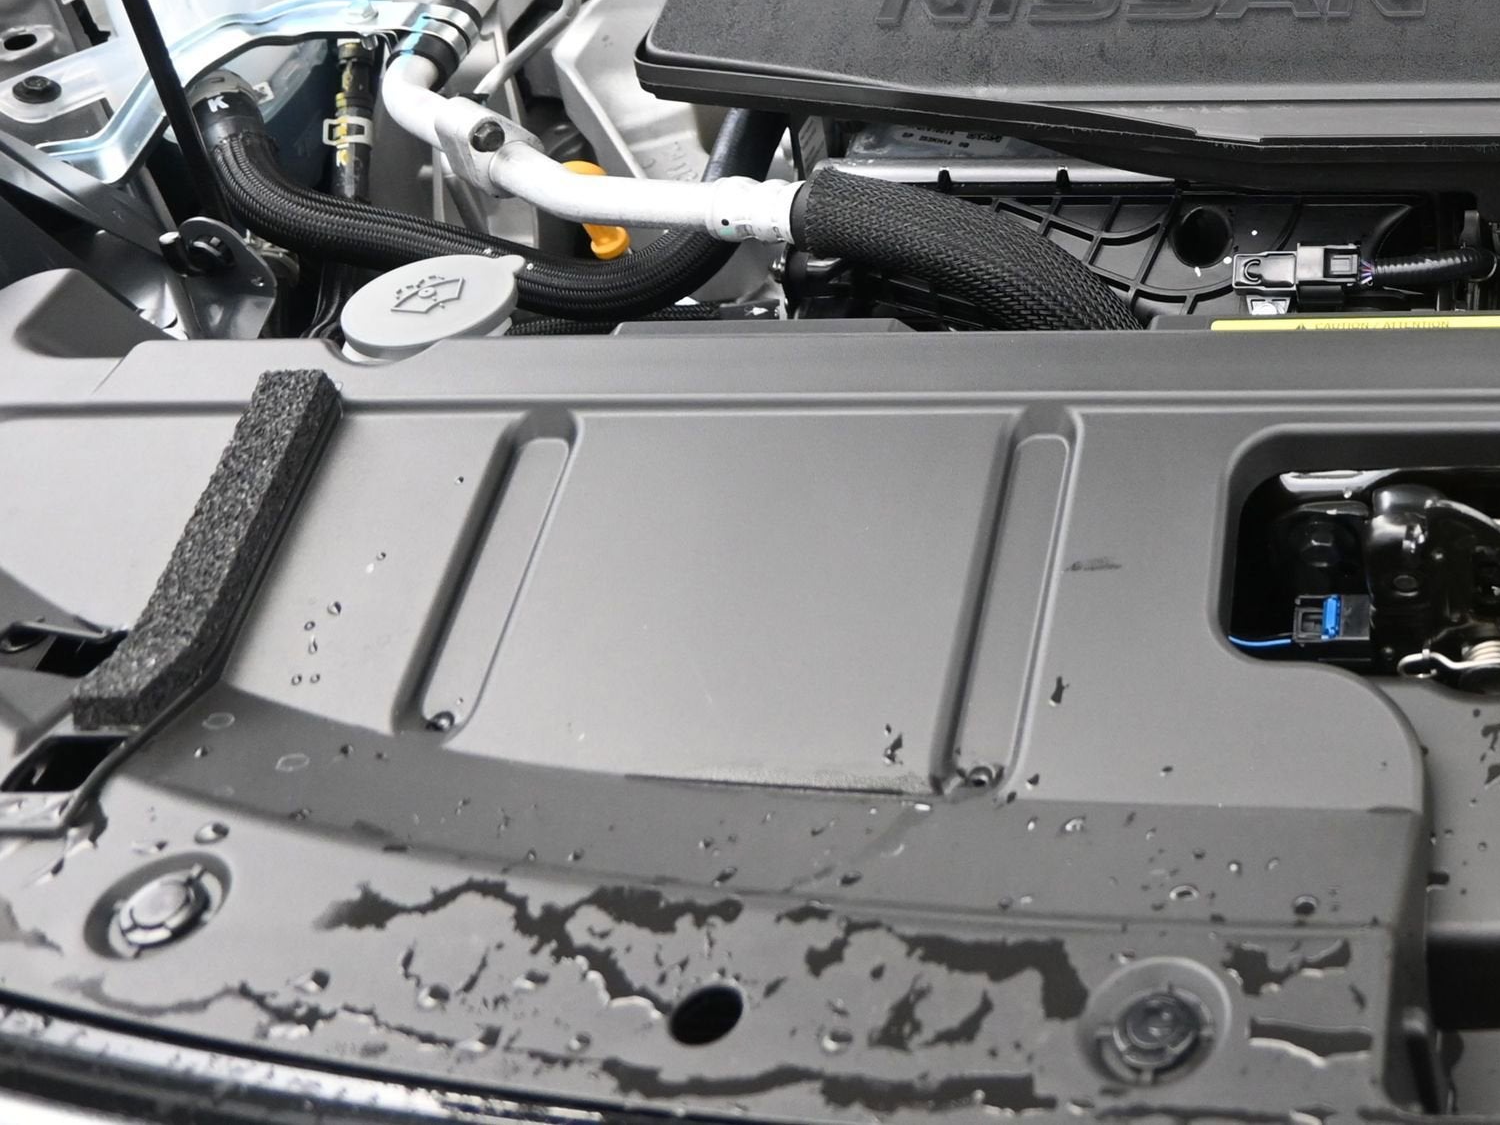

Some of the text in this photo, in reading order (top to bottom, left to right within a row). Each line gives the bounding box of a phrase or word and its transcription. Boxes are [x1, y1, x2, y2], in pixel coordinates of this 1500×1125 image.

[208, 95, 229, 113] K
[1315, 322, 1369, 330] CAUTION
[1383, 321, 1450, 329] ATTENTION
